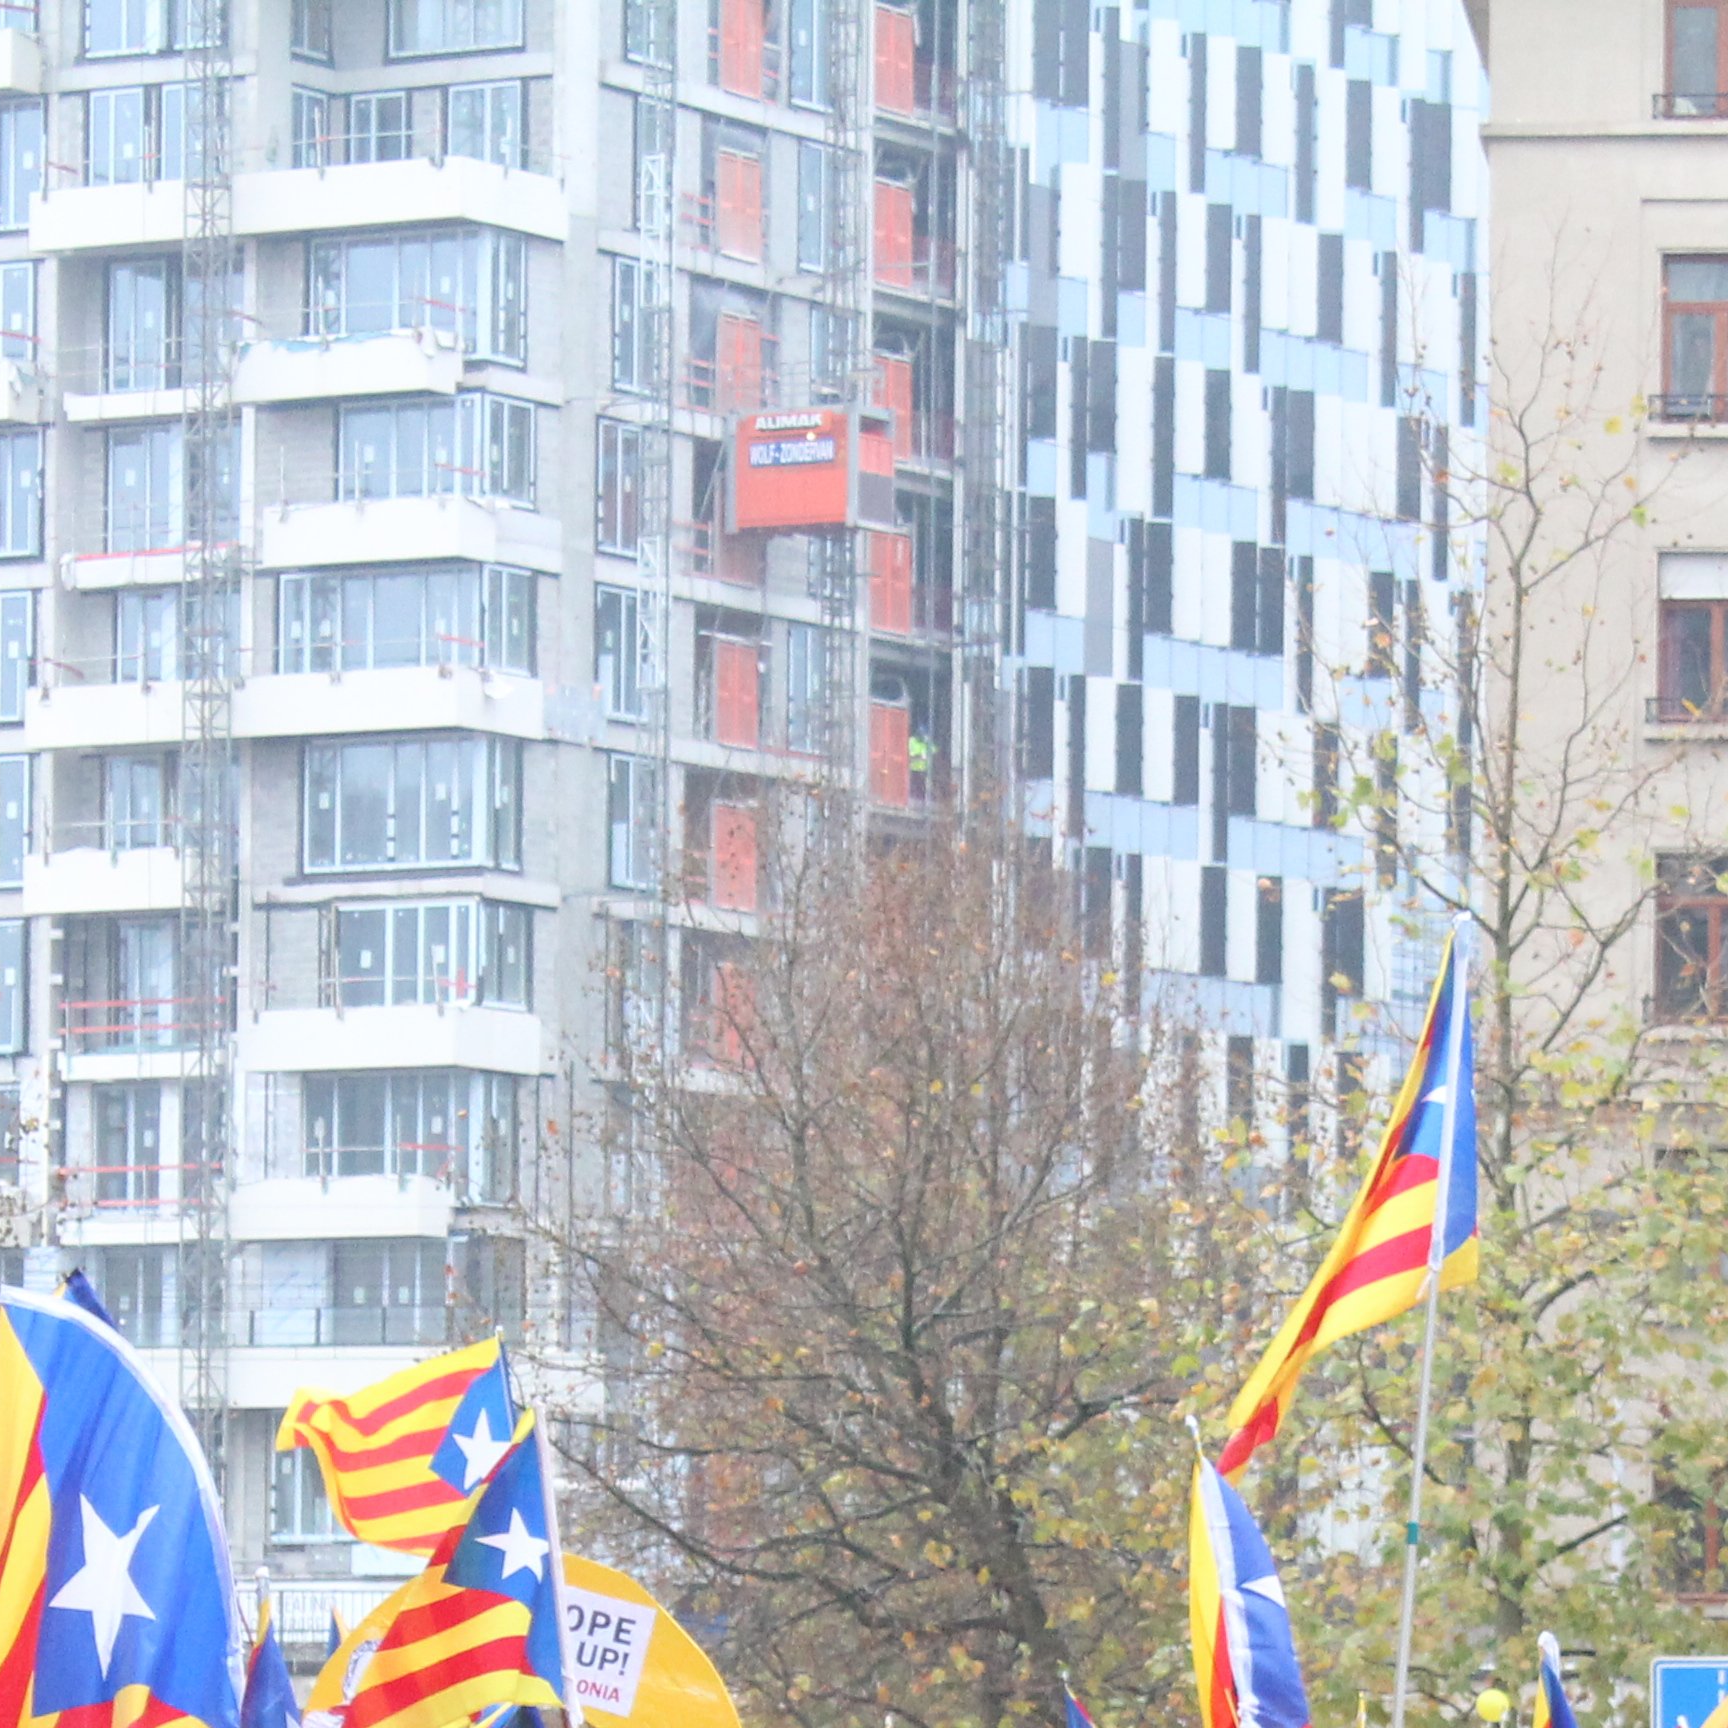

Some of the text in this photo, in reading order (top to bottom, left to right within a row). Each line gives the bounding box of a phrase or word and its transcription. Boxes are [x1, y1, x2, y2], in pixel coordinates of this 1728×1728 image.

[755, 413, 823, 431] ALIMAK
[576, 1640, 630, 1677] UP!
[576, 1679, 621, 1703] ONIA
